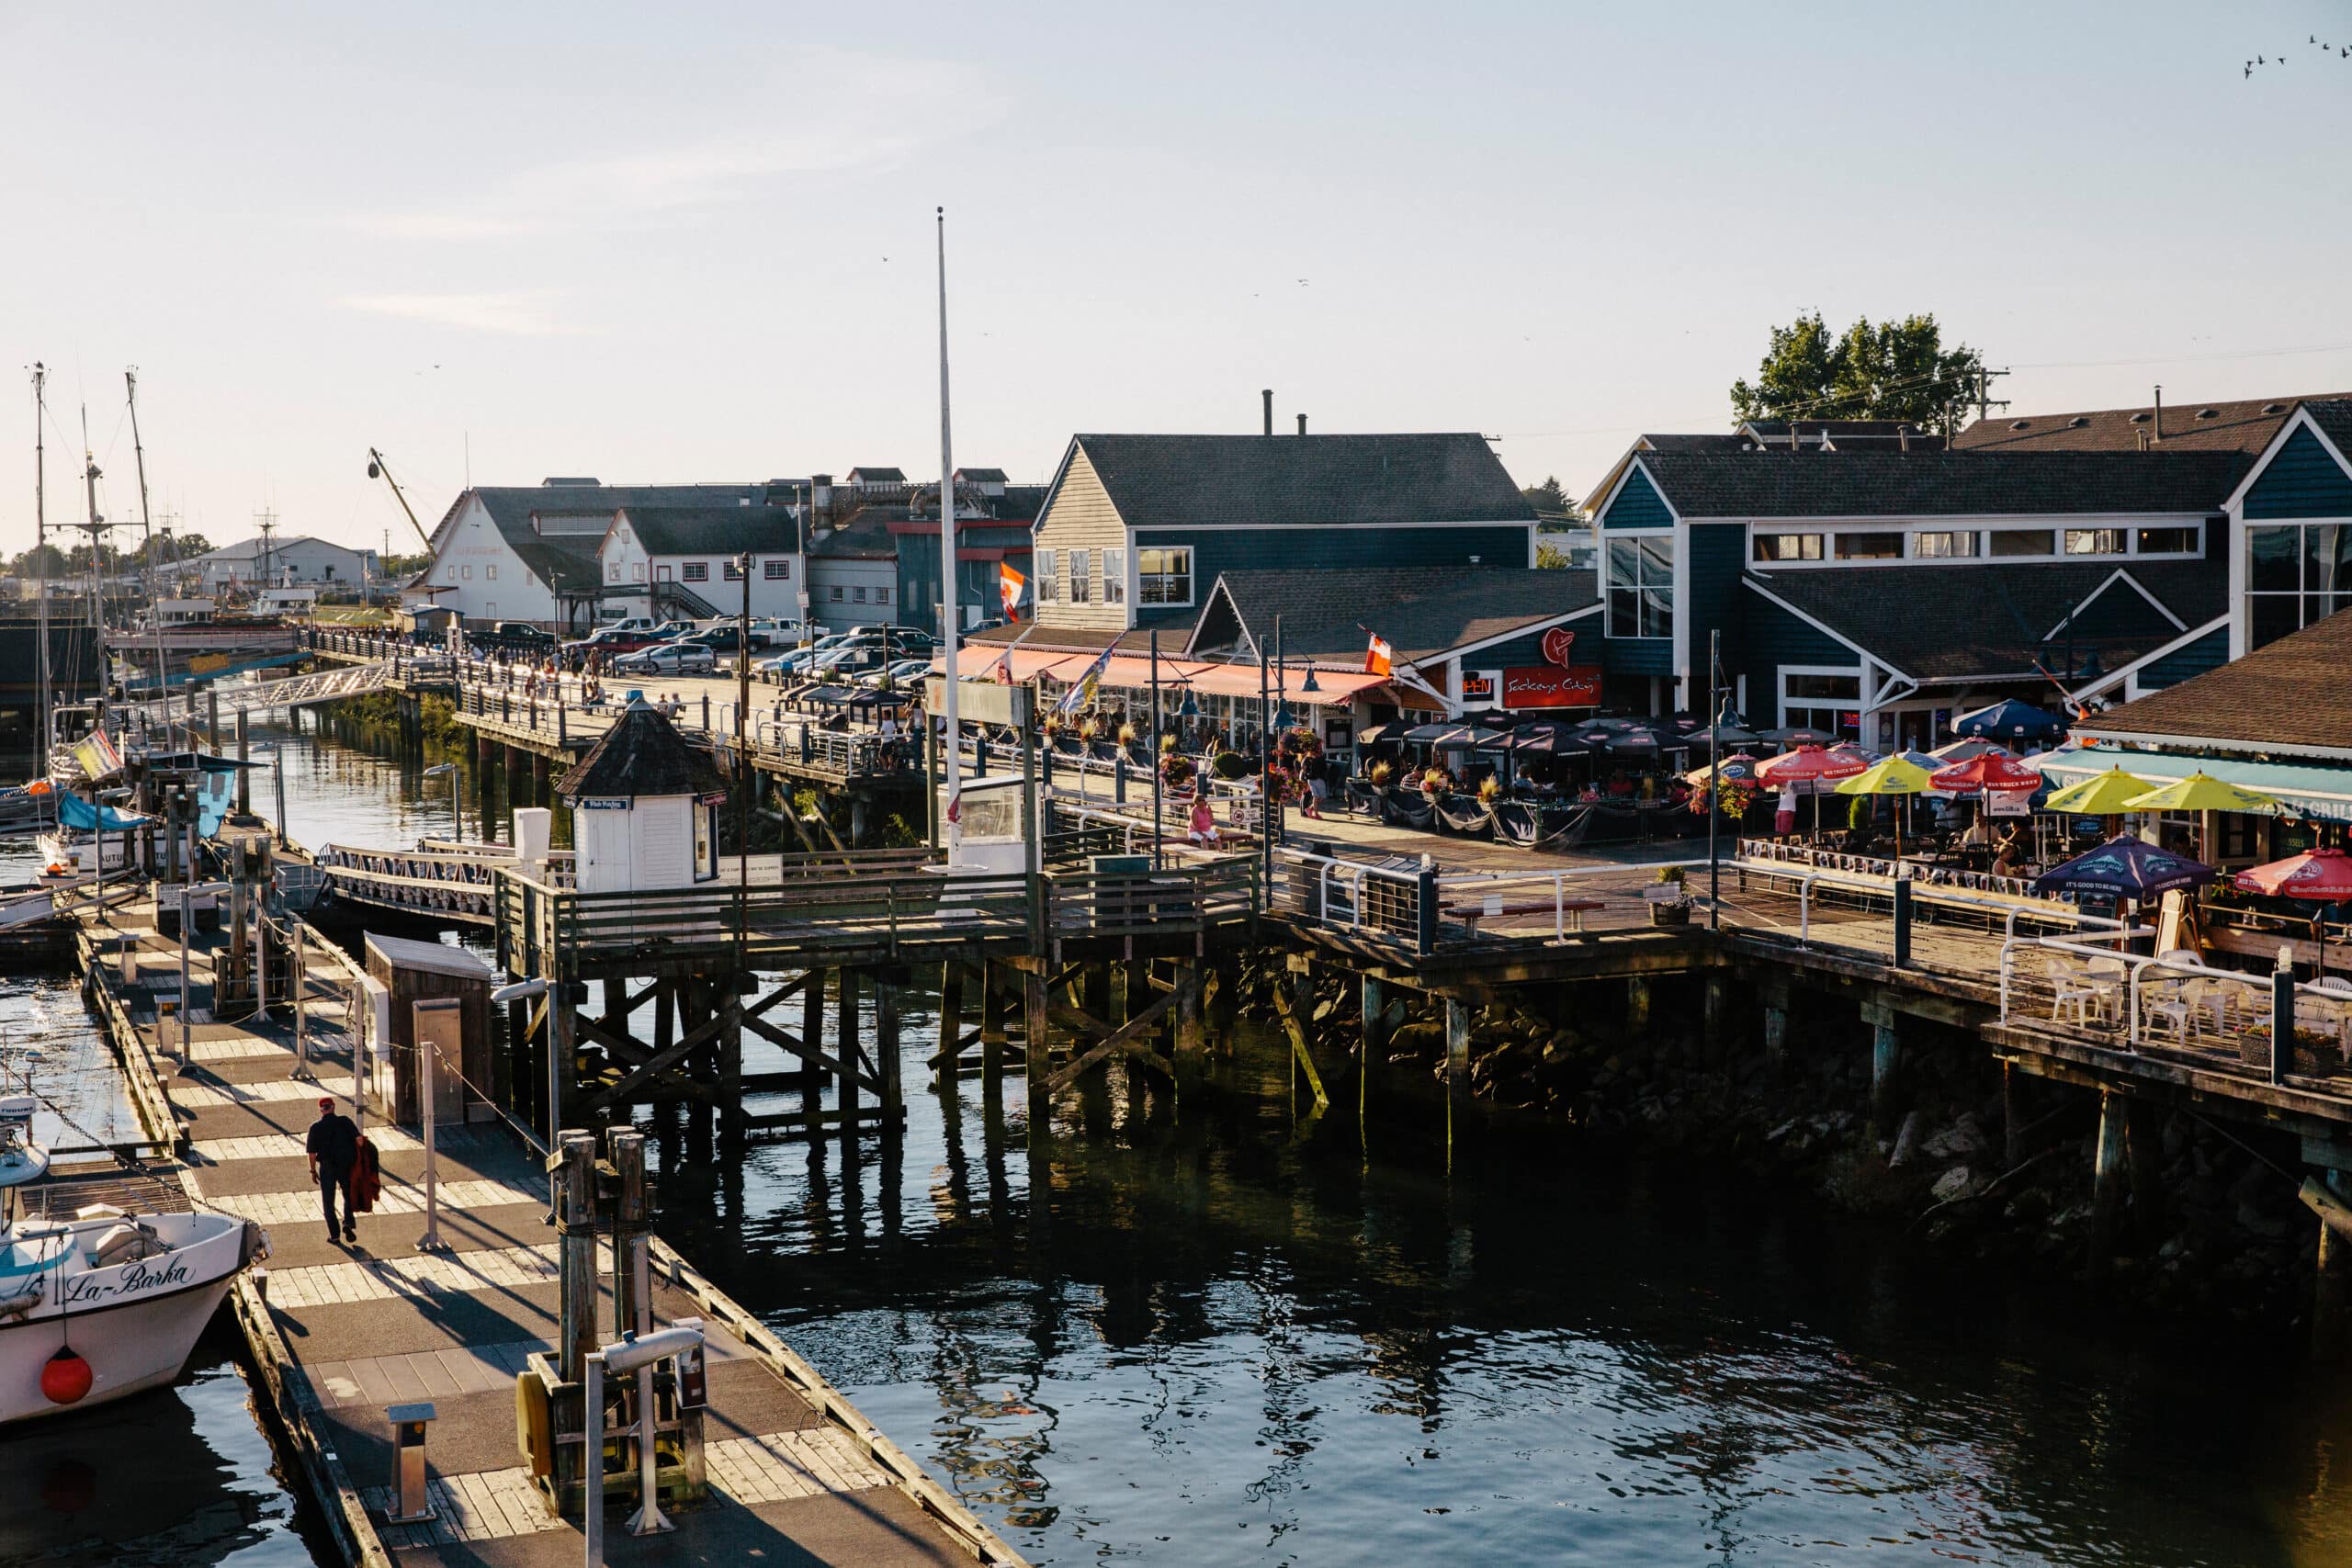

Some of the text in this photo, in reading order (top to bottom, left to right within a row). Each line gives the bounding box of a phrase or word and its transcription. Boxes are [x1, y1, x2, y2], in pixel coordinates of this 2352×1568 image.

[1508, 678, 1556, 694] Sockeye
[1562, 677, 1594, 694] City
[1, 1105, 33, 1113] FURUNO
[63, 1253, 197, 1303] La-Barka
